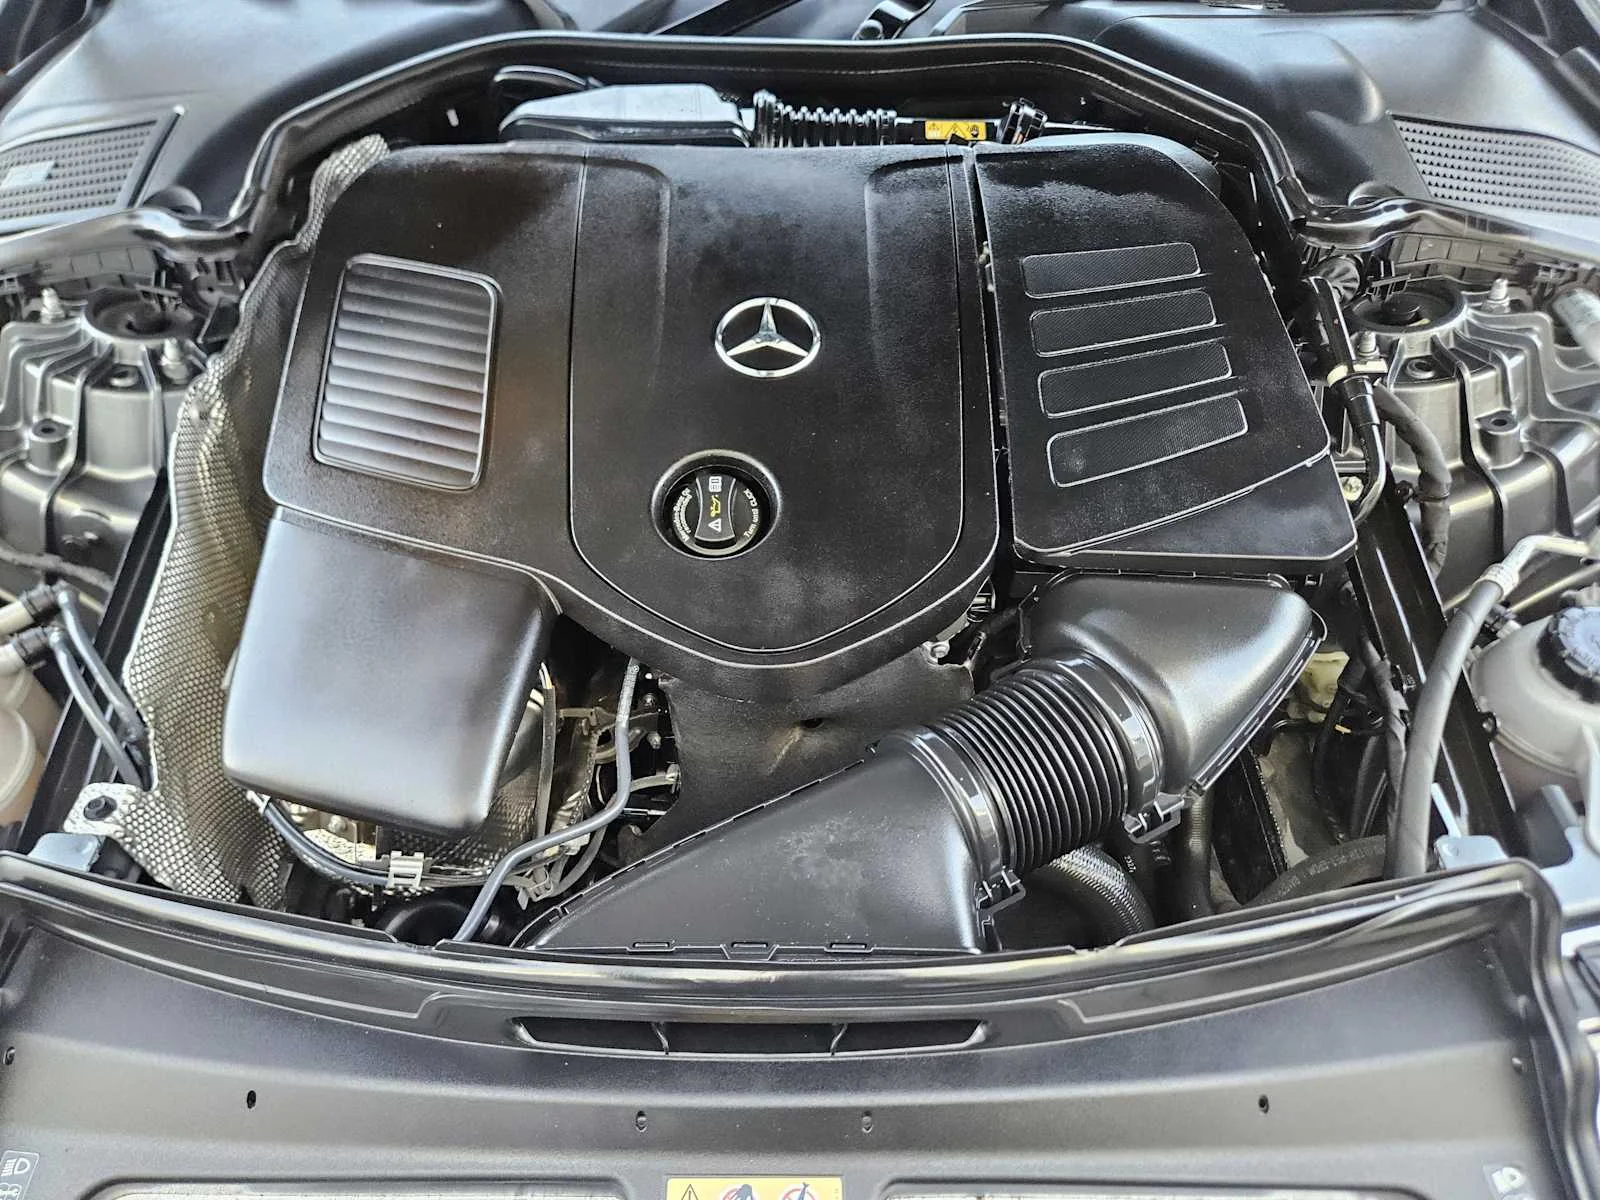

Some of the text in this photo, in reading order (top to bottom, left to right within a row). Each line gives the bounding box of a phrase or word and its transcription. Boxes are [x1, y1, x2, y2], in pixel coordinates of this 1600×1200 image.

[743, 488, 759, 538] Turn until CLICK
